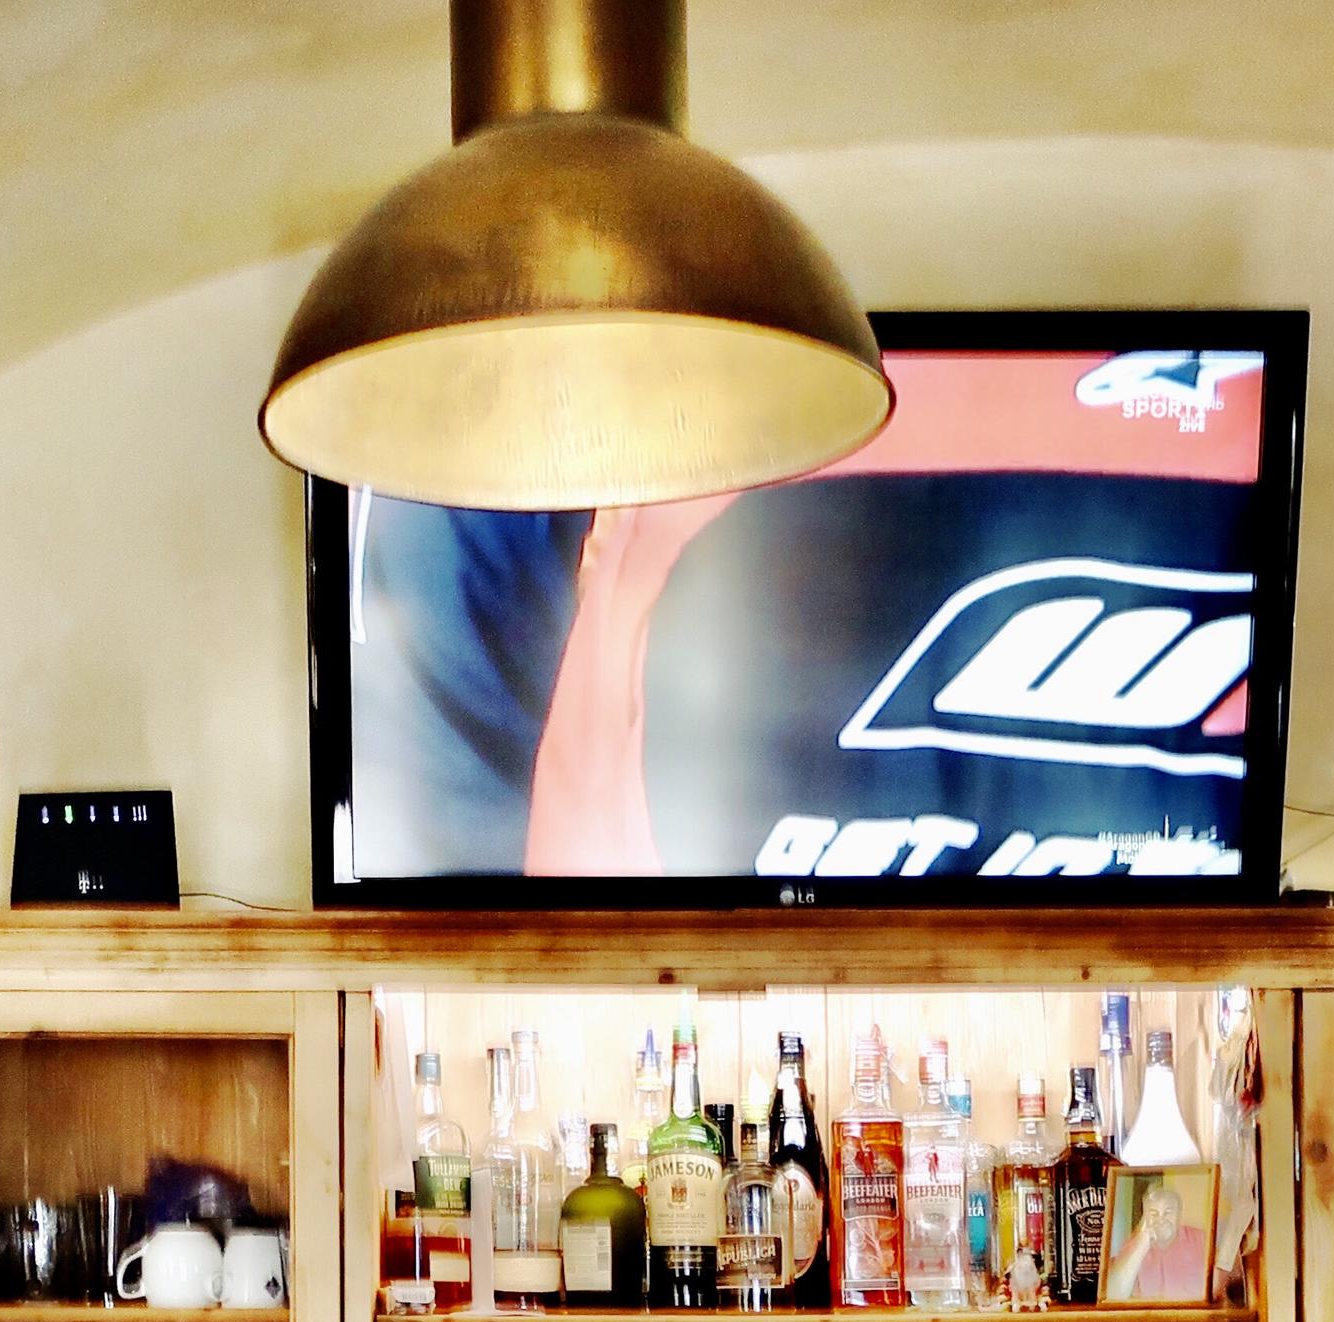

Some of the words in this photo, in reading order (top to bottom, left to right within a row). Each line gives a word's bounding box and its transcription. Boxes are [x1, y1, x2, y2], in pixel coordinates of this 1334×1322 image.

[650, 1161, 715, 1182] JAMESON
[843, 1183, 898, 1200] BEEFEATER
[906, 1184, 963, 1200] BEEFEATER
